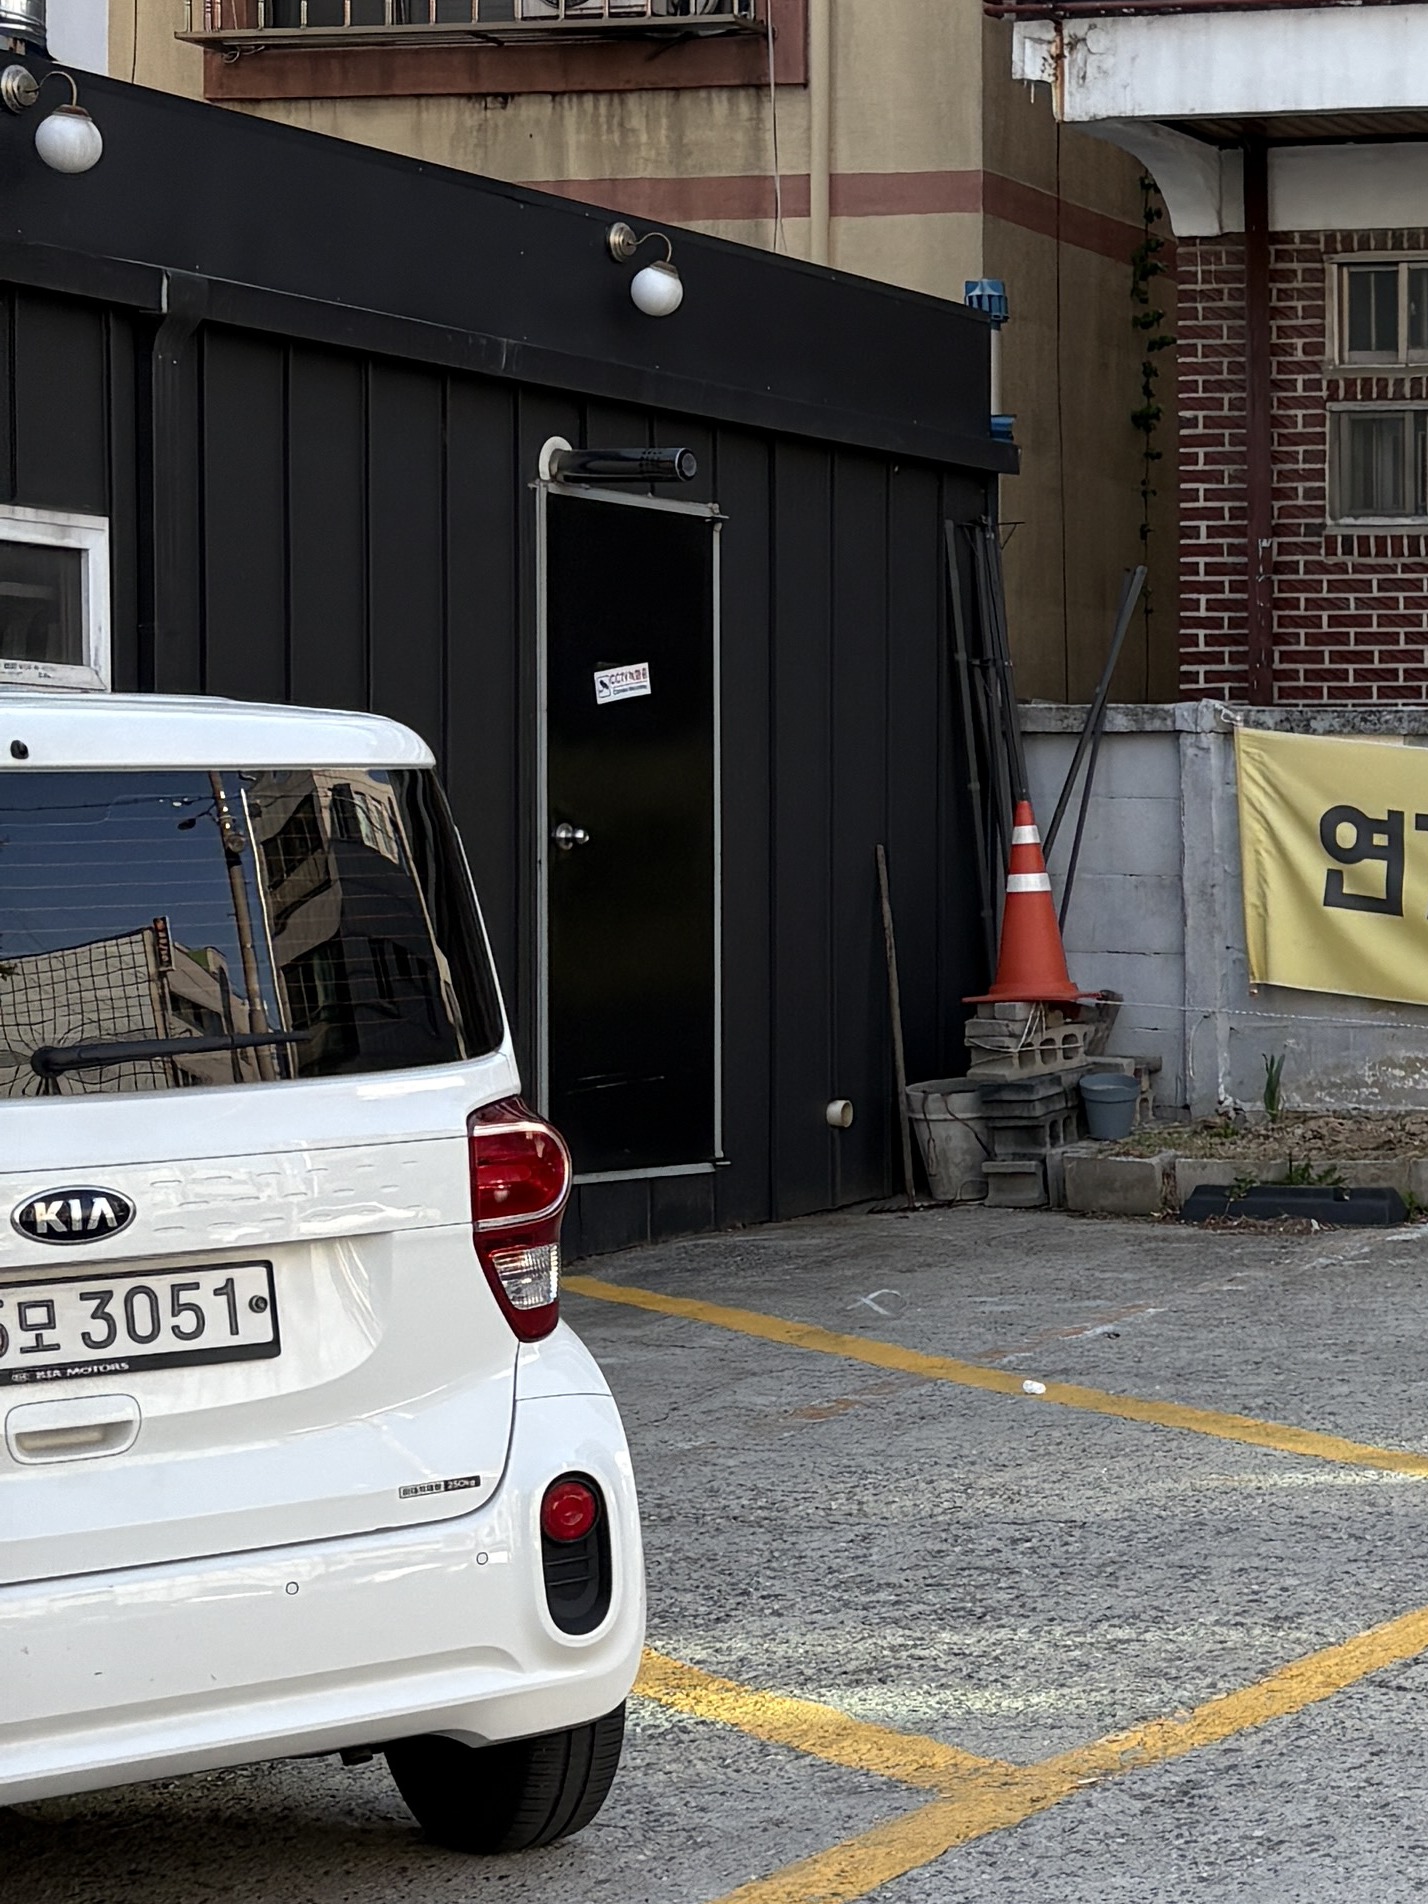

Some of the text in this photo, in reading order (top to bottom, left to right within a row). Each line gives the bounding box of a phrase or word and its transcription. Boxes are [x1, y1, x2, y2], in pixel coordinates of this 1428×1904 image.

[33, 1196, 118, 1234] KIA
[79, 1277, 240, 1350] 3051
[36, 1369, 61, 1380] KIA
[67, 1362, 130, 1377] MOTORS
